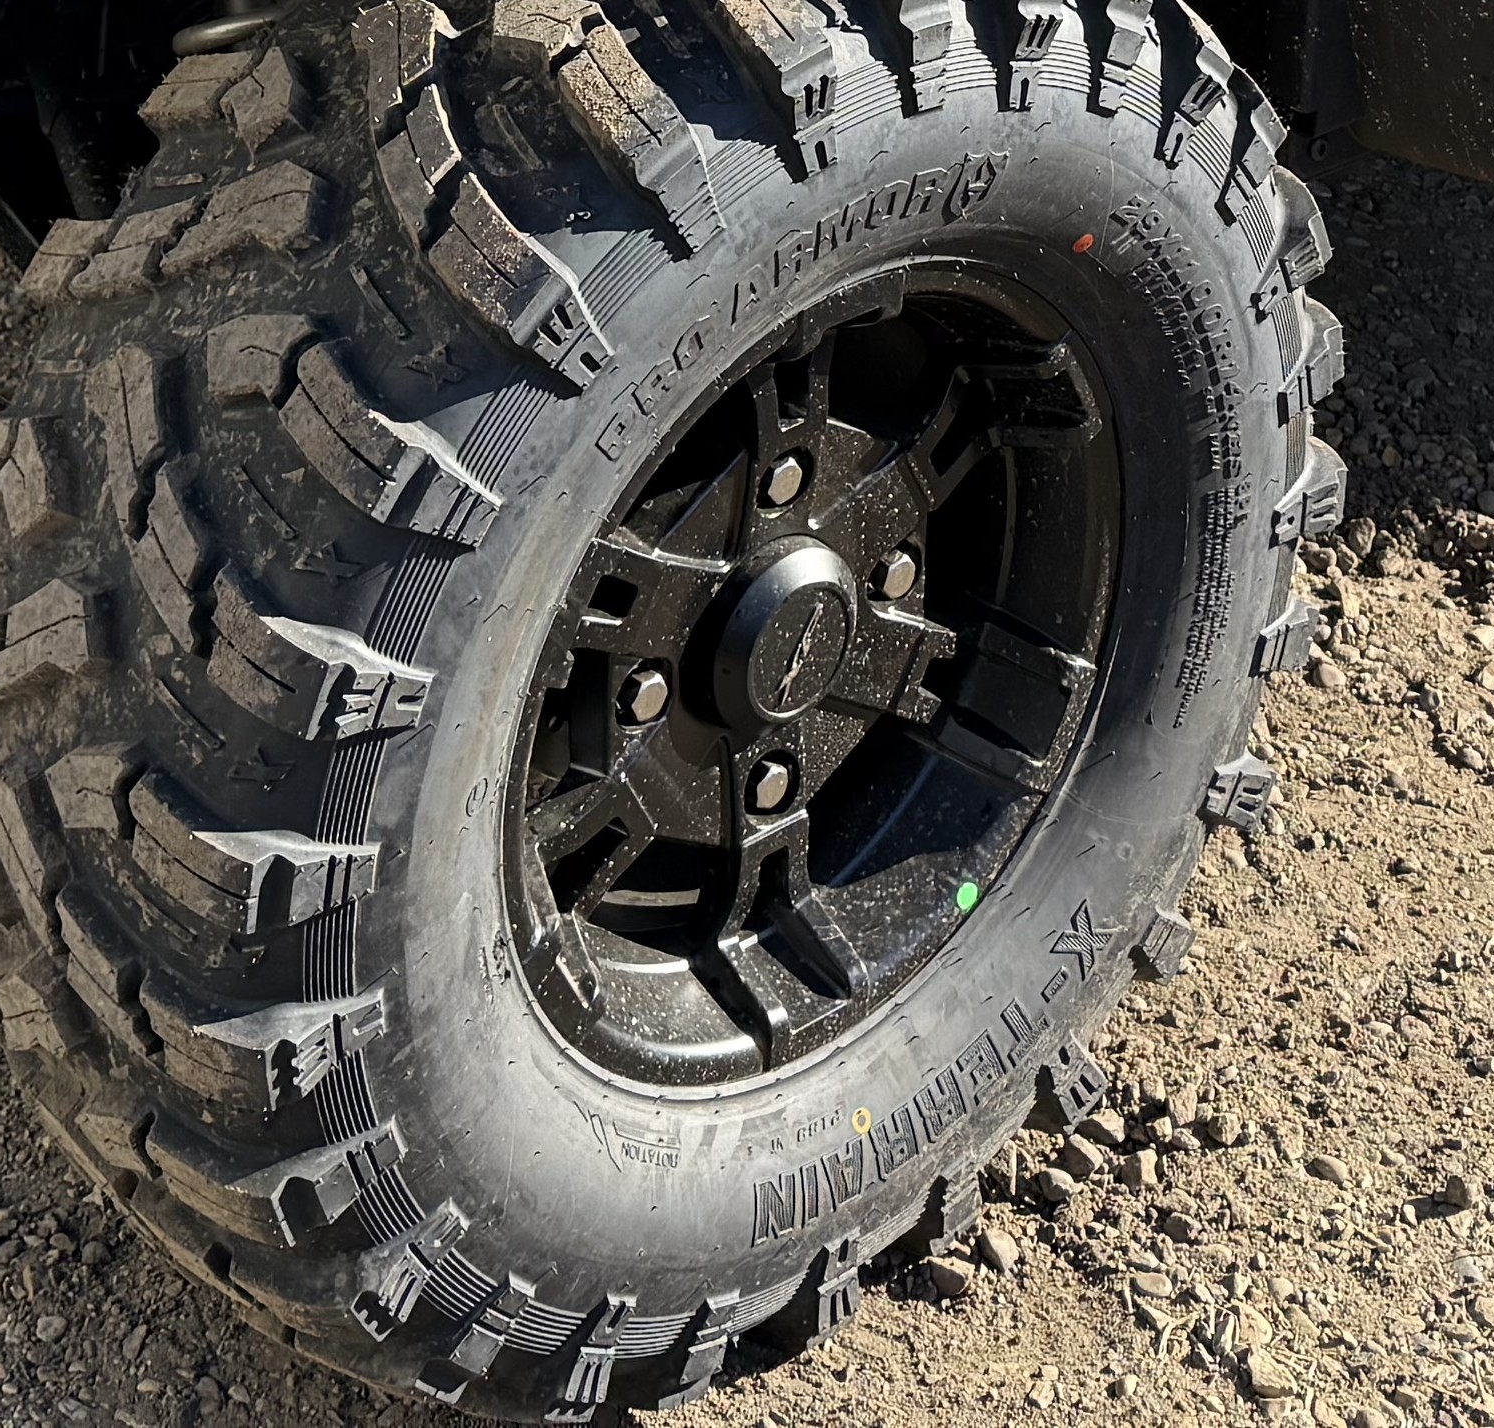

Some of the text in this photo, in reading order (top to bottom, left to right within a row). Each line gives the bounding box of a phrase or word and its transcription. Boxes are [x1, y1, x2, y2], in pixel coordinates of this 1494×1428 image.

[597, 316, 712, 463] PRO
[729, 166, 951, 332] ARMOR
[621, 1140, 682, 1169] ROTATION
[752, 897, 1117, 1248] X-TERRAIN
